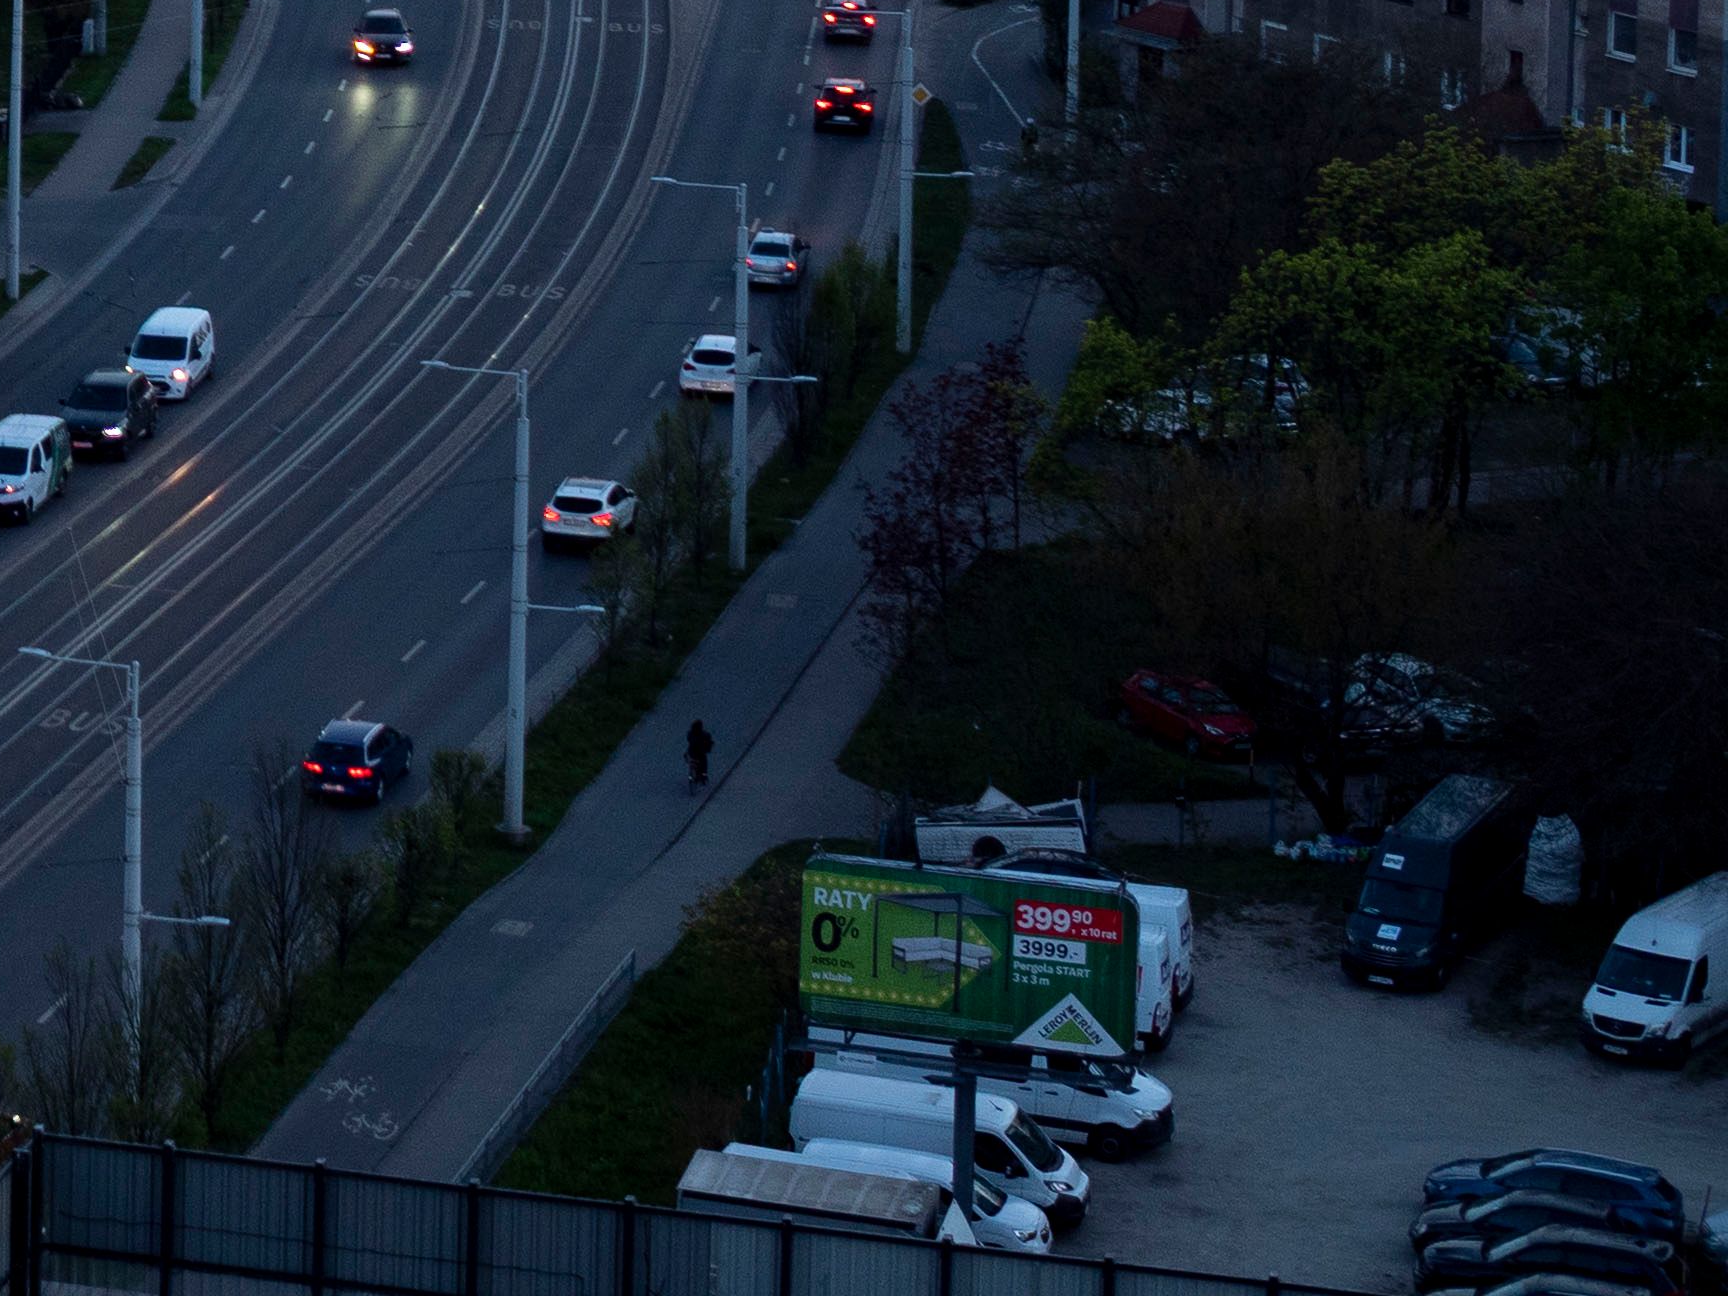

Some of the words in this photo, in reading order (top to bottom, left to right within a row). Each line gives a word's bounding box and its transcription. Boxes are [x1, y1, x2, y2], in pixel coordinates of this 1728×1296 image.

[813, 886, 873, 912] RATY
[811, 911, 860, 953] 0%
[1101, 930, 1118, 941] rat
[1012, 960, 1055, 975] Pergola
[1055, 965, 1092, 978] START
[1038, 1010, 1069, 1038] LEROY
[1065, 1004, 1103, 1045] MERLIN
